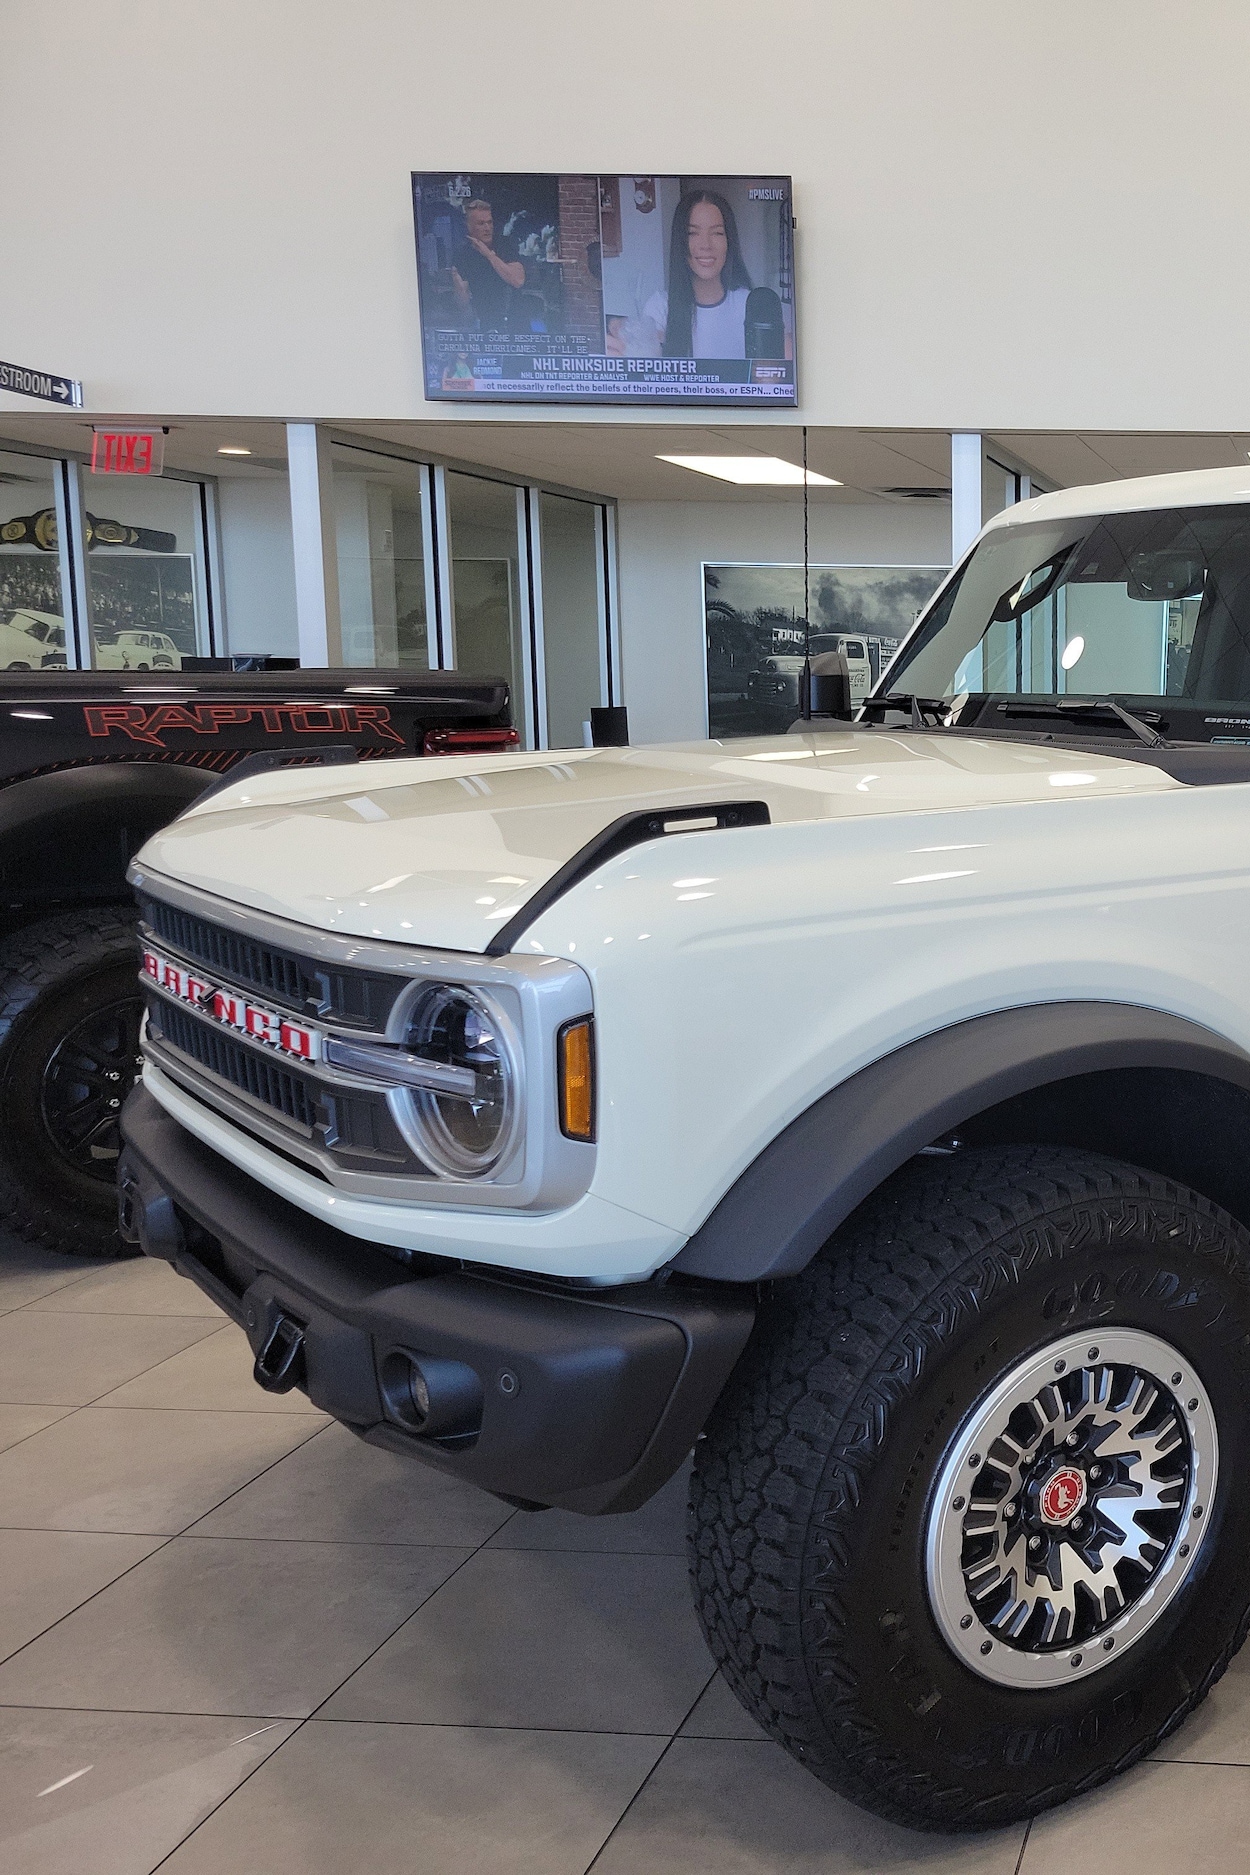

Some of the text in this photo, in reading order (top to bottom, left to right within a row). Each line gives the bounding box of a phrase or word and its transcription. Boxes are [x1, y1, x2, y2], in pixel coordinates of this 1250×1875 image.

[749, 189, 784, 200] #PMSLIVE
[468, 333, 484, 342] PUT
[489, 334, 510, 342] SOME
[514, 334, 551, 343] RESPECT
[555, 335, 567, 343] ON
[570, 335, 587, 343] THE
[439, 343, 481, 352] CAROLINA
[547, 345, 573, 354] IT'LL
[576, 345, 588, 354] BE
[533, 357, 697, 373] NHL RINKSIDE REPORTER
[521, 371, 535, 380] NHL
[535, 372, 544, 380] ON
[545, 372, 558, 380] TNT
[558, 373, 593, 381] REPORTER
[600, 373, 628, 381] ANALYST
[643, 374, 660, 382] WWE
[660, 374, 679, 382] HOST
[755, 367, 787, 378] ESPN
[0, 365, 51, 397] STROOM
[483, 382, 495, 390] ot
[497, 382, 545, 392] necessarily
[546, 383, 574, 391] reflect
[576, 384, 590, 392] the
[592, 384, 621, 392] beliefs
[622, 384, 632, 392] of
[633, 385, 653, 393] their
[655, 386, 681, 394] peers,
[683, 386, 703, 394] their
[705, 386, 727, 395] boss,
[740, 387, 771, 395] ESPN...
[83, 705, 405, 748] RAPTOR
[143, 949, 322, 1060] BRONCO
